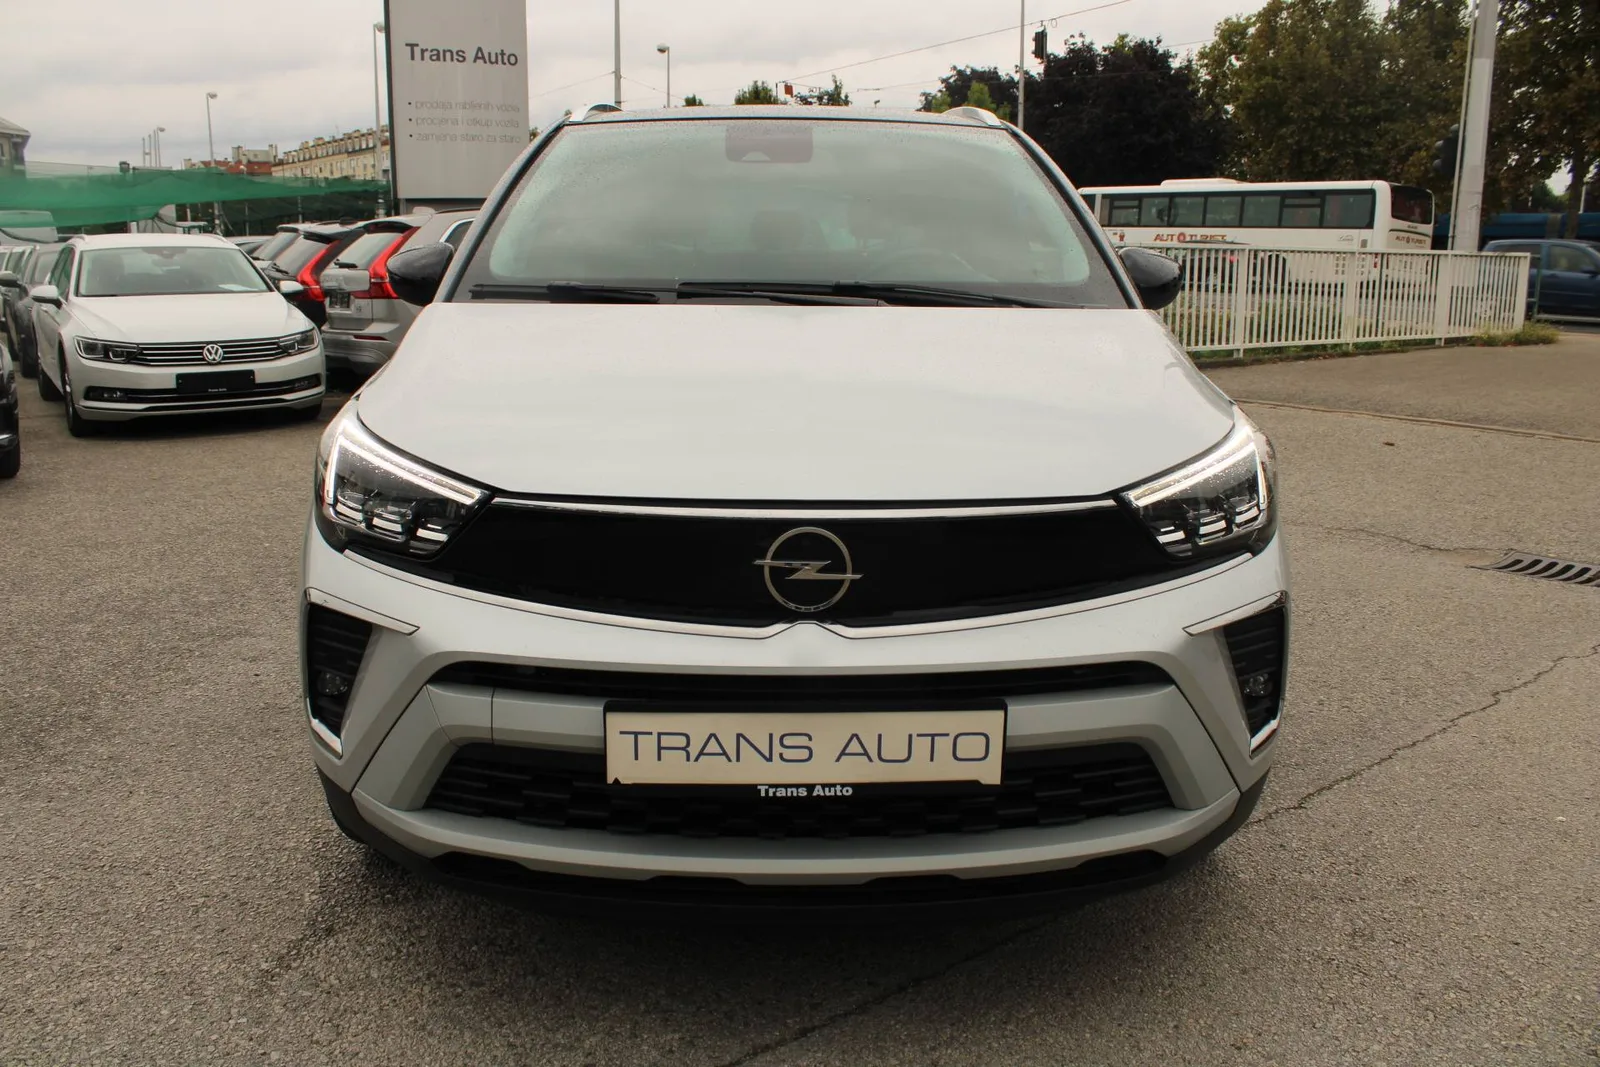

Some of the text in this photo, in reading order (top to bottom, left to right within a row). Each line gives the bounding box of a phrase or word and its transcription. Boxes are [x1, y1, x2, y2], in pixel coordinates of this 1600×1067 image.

[405, 43, 518, 66] Trans Auto
[415, 100, 520, 112] prodaja rabljenih vozila
[416, 116, 459, 127] procjena
[467, 118, 493, 128] otkup
[495, 118, 520, 128] vozila
[416, 132, 522, 143] zamjena staro za staro
[619, 730, 990, 763] TRANS AUTO
[757, 785, 853, 797] Trans Auto
